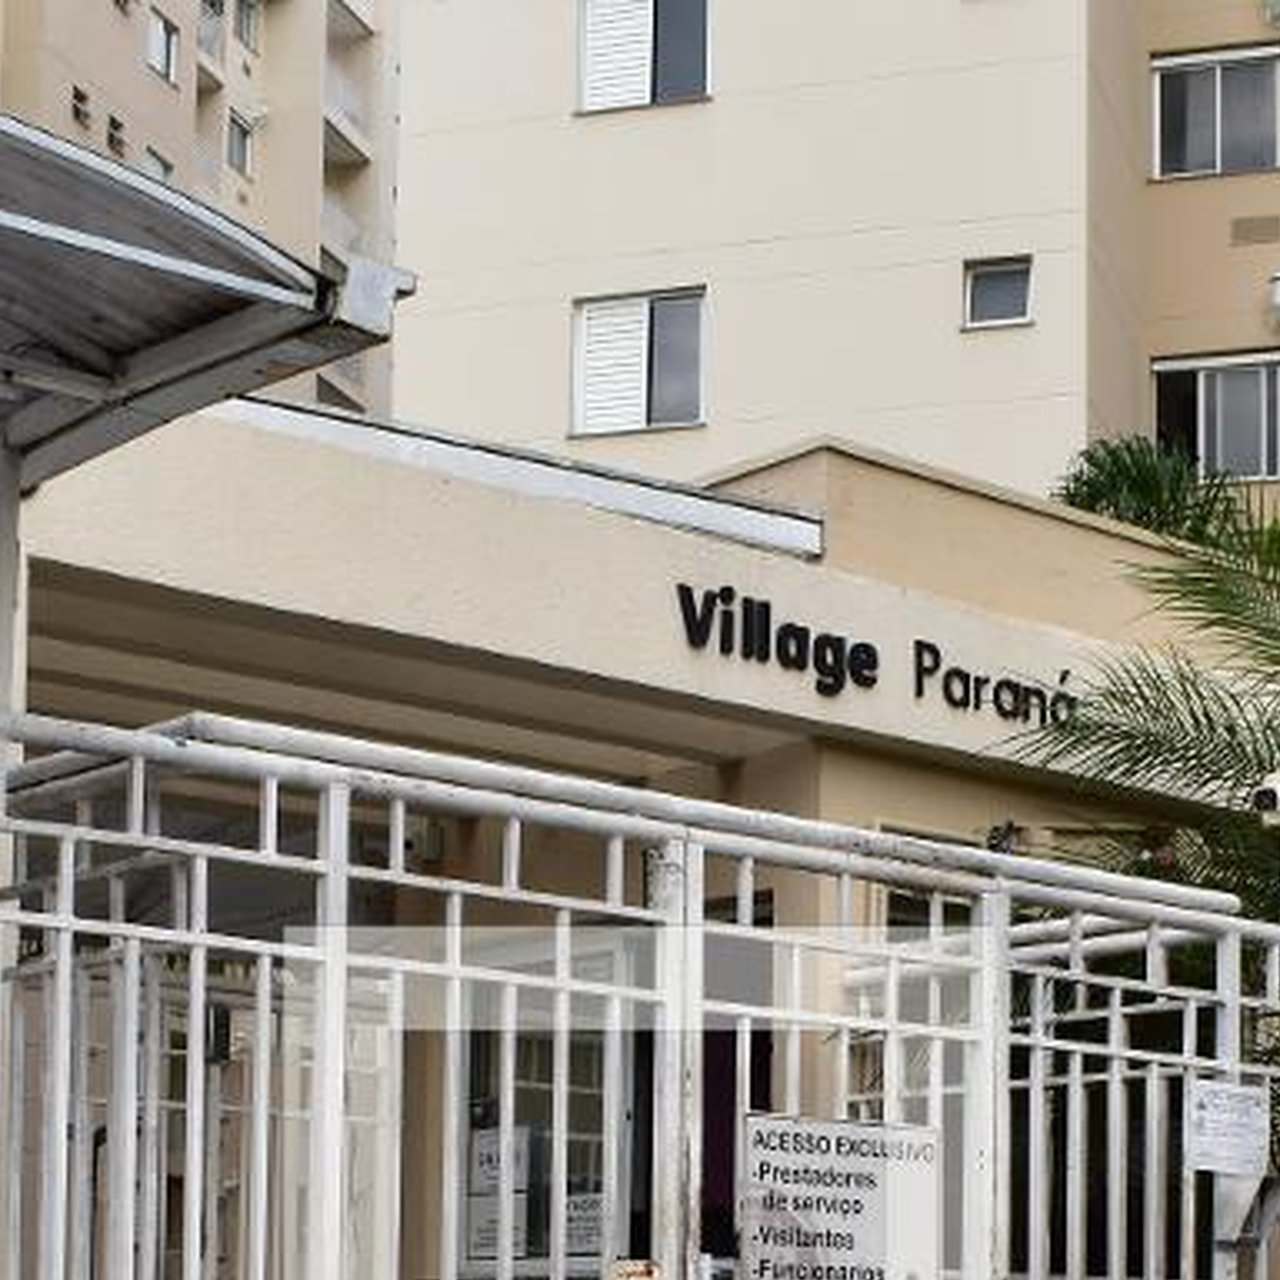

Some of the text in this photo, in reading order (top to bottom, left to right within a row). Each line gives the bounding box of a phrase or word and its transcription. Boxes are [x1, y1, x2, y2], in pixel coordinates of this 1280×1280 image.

[675, 583, 1079, 728] Village Paraná
[753, 1130, 936, 1164] ACESSO EXCLUSIVO
[762, 1189, 865, 1222] de serviço
